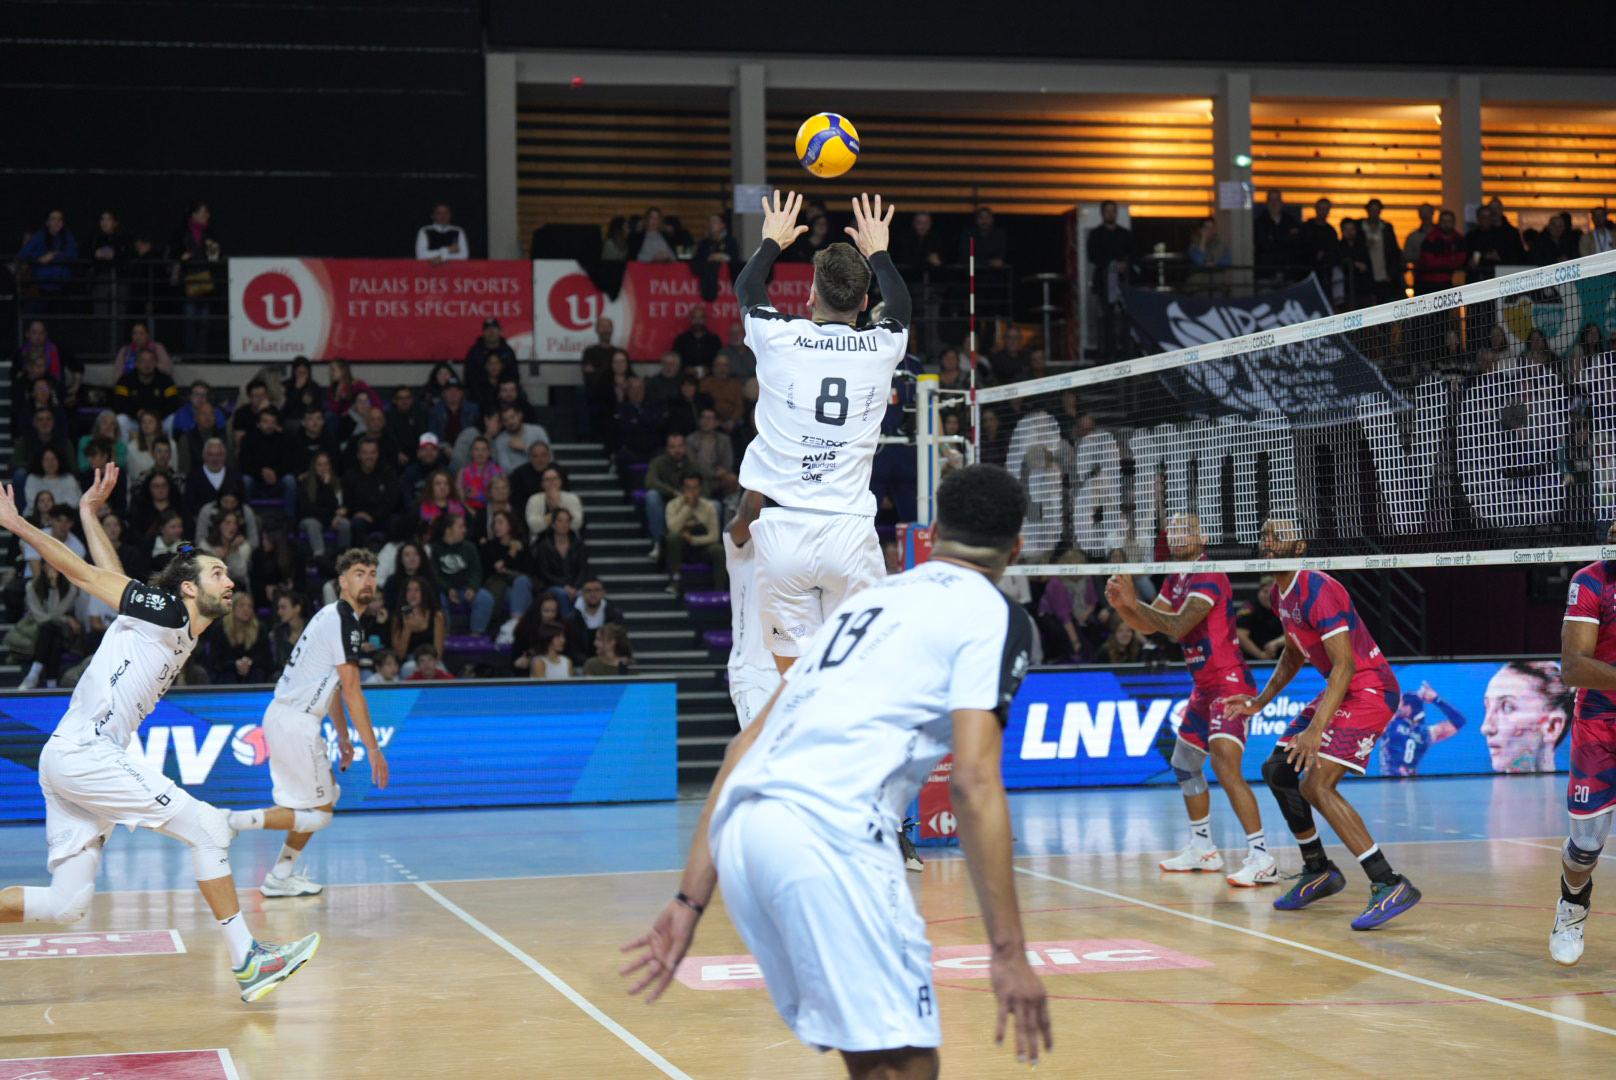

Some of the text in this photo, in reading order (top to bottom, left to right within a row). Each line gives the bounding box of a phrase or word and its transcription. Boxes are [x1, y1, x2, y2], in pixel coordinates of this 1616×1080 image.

[1554, 264, 1581, 282] CORSE
[349, 276, 521, 294] PALAIS DES SPORTS
[649, 279, 700, 295] PALAI
[347, 300, 522, 318] ET DES SPECTACLES
[648, 301, 670, 318] ET
[1433, 291, 1463, 311] CORSICA
[1343, 314, 1363, 328] CORSE
[1252, 334, 1275, 349] CORSICA
[814, 377, 849, 427] 8
[802, 450, 836, 461] AVIS
[1365, 557, 1391, 568] Gamm vert
[1435, 554, 1451, 566] Gamm
[1453, 553, 1465, 565] vert
[1513, 550, 1532, 563] Gamm
[1533, 550, 1546, 562] vert
[819, 607, 884, 671] 13
[110, 659, 131, 687] SICA
[1019, 698, 1173, 760] LNV
[1250, 715, 1287, 736] live
[126, 724, 235, 785] NV
[316, 786, 324, 798] 5
[1574, 785, 1590, 803] 20
